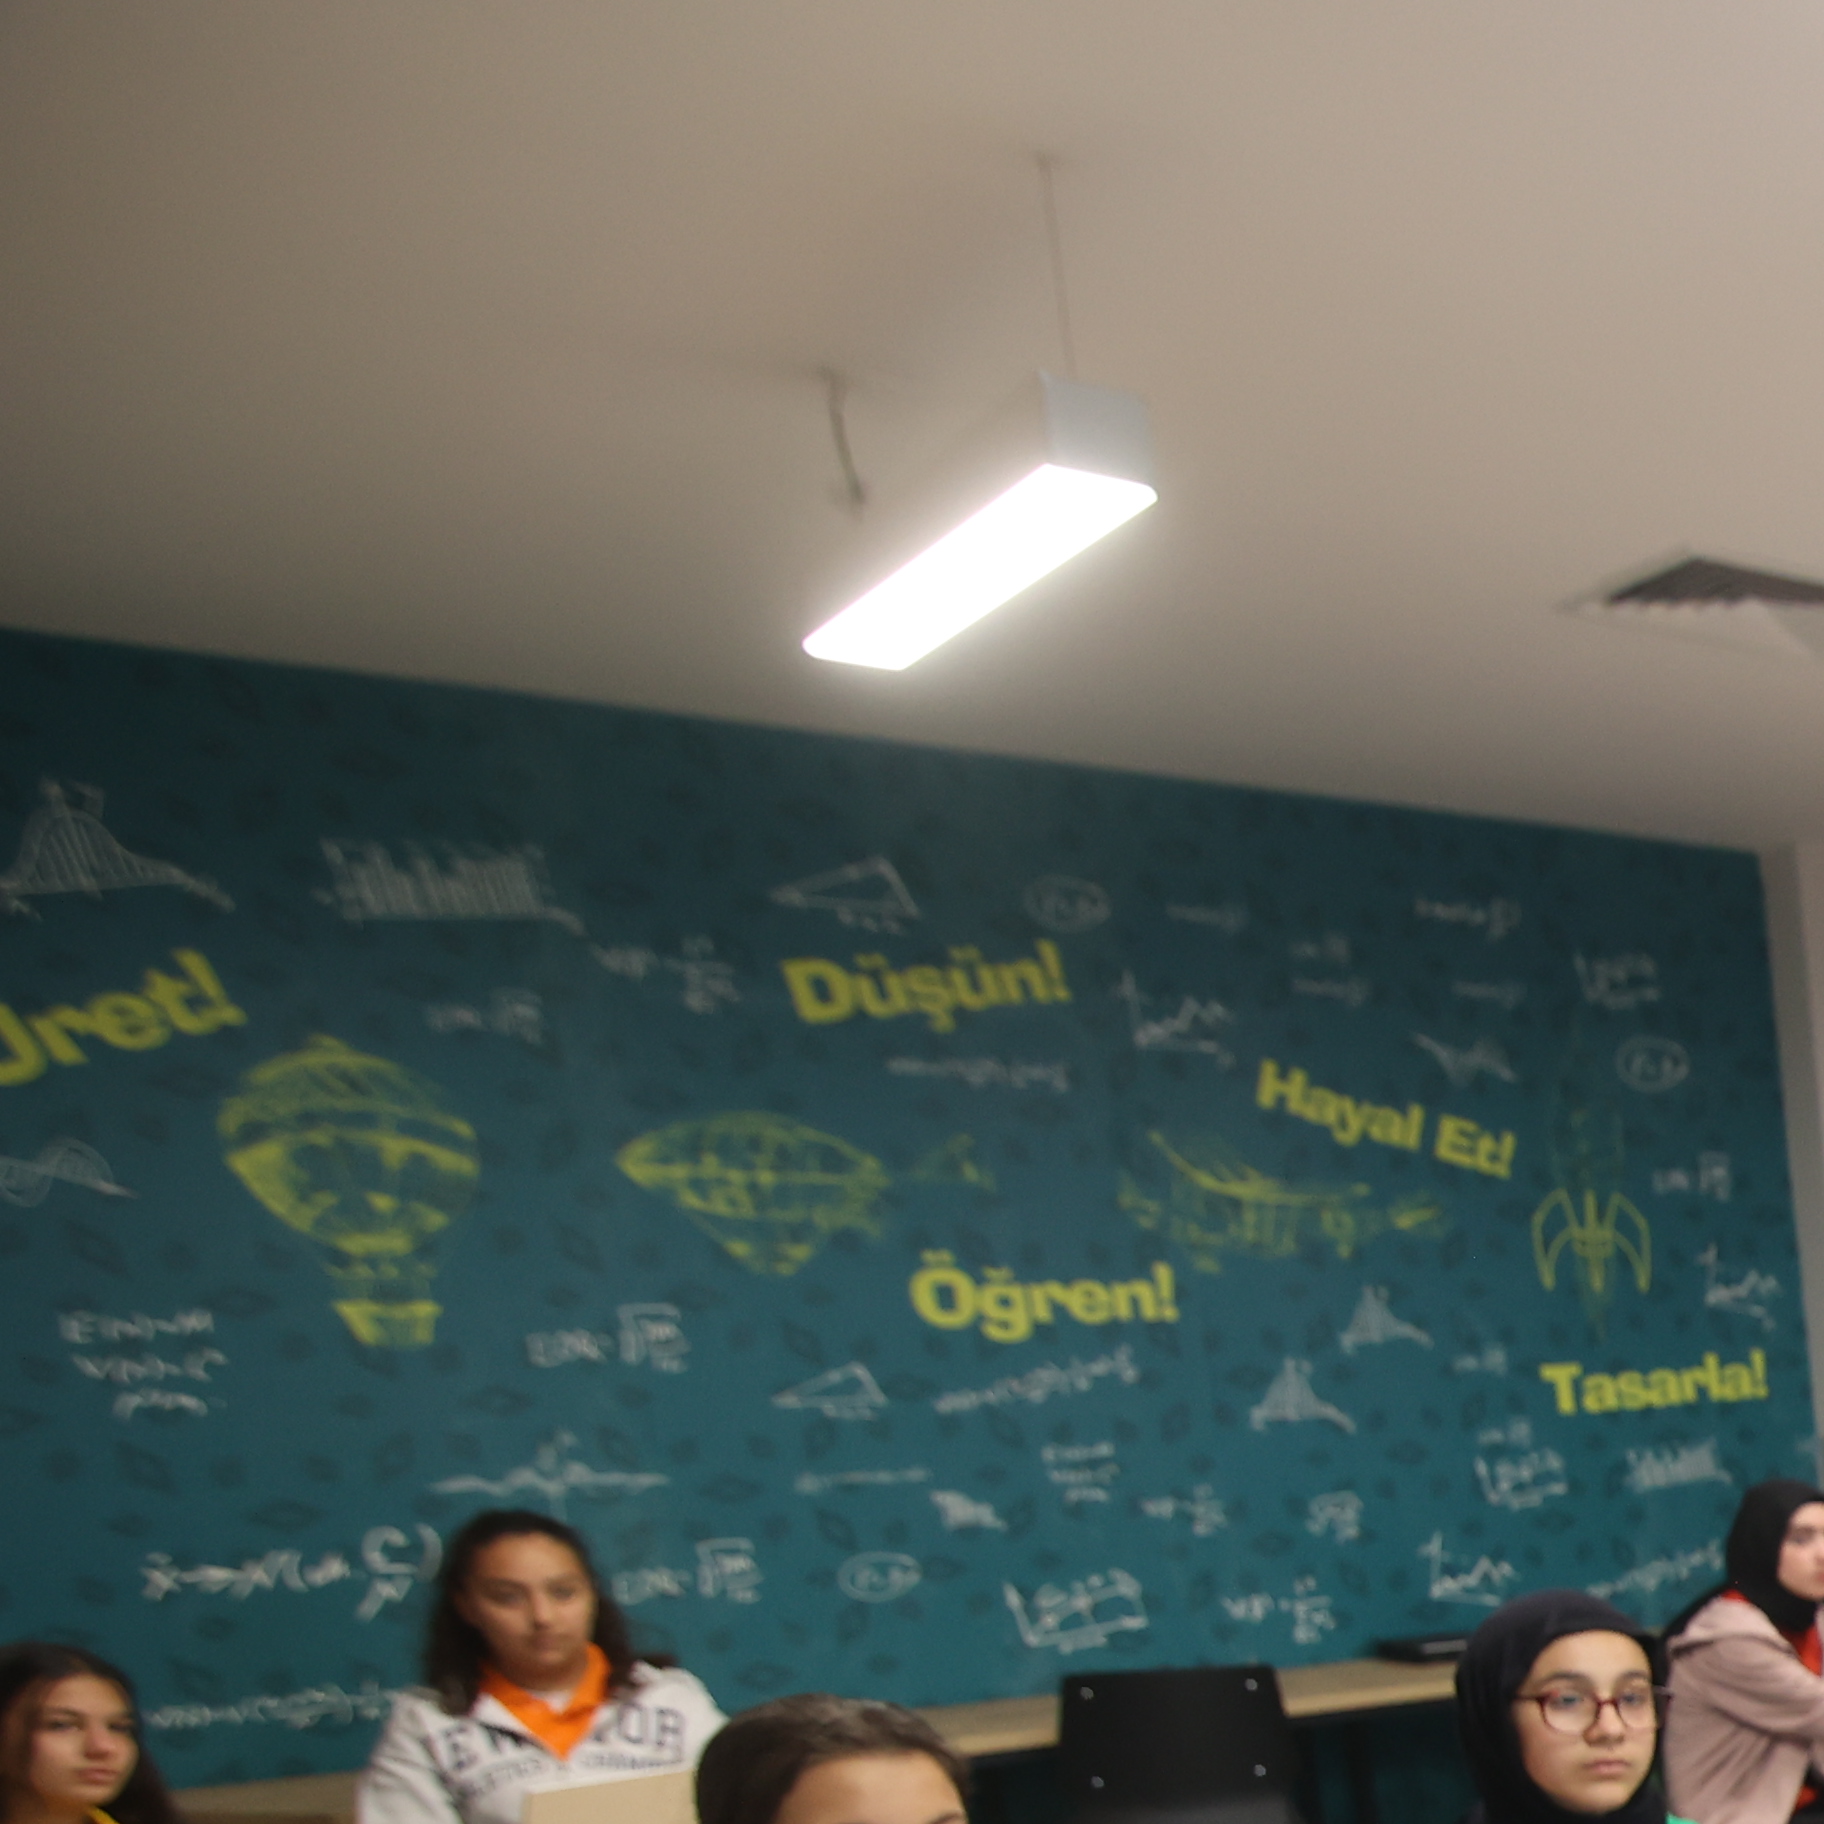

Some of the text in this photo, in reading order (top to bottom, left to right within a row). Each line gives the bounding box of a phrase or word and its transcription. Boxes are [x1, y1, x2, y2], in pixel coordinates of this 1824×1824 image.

[782, 938, 1072, 1033] Düşün!
[1256, 1058, 1517, 1178] Hayal Et!
[909, 1250, 1179, 1344] Öğren!
[1539, 1348, 1770, 1416] Tasarla!
